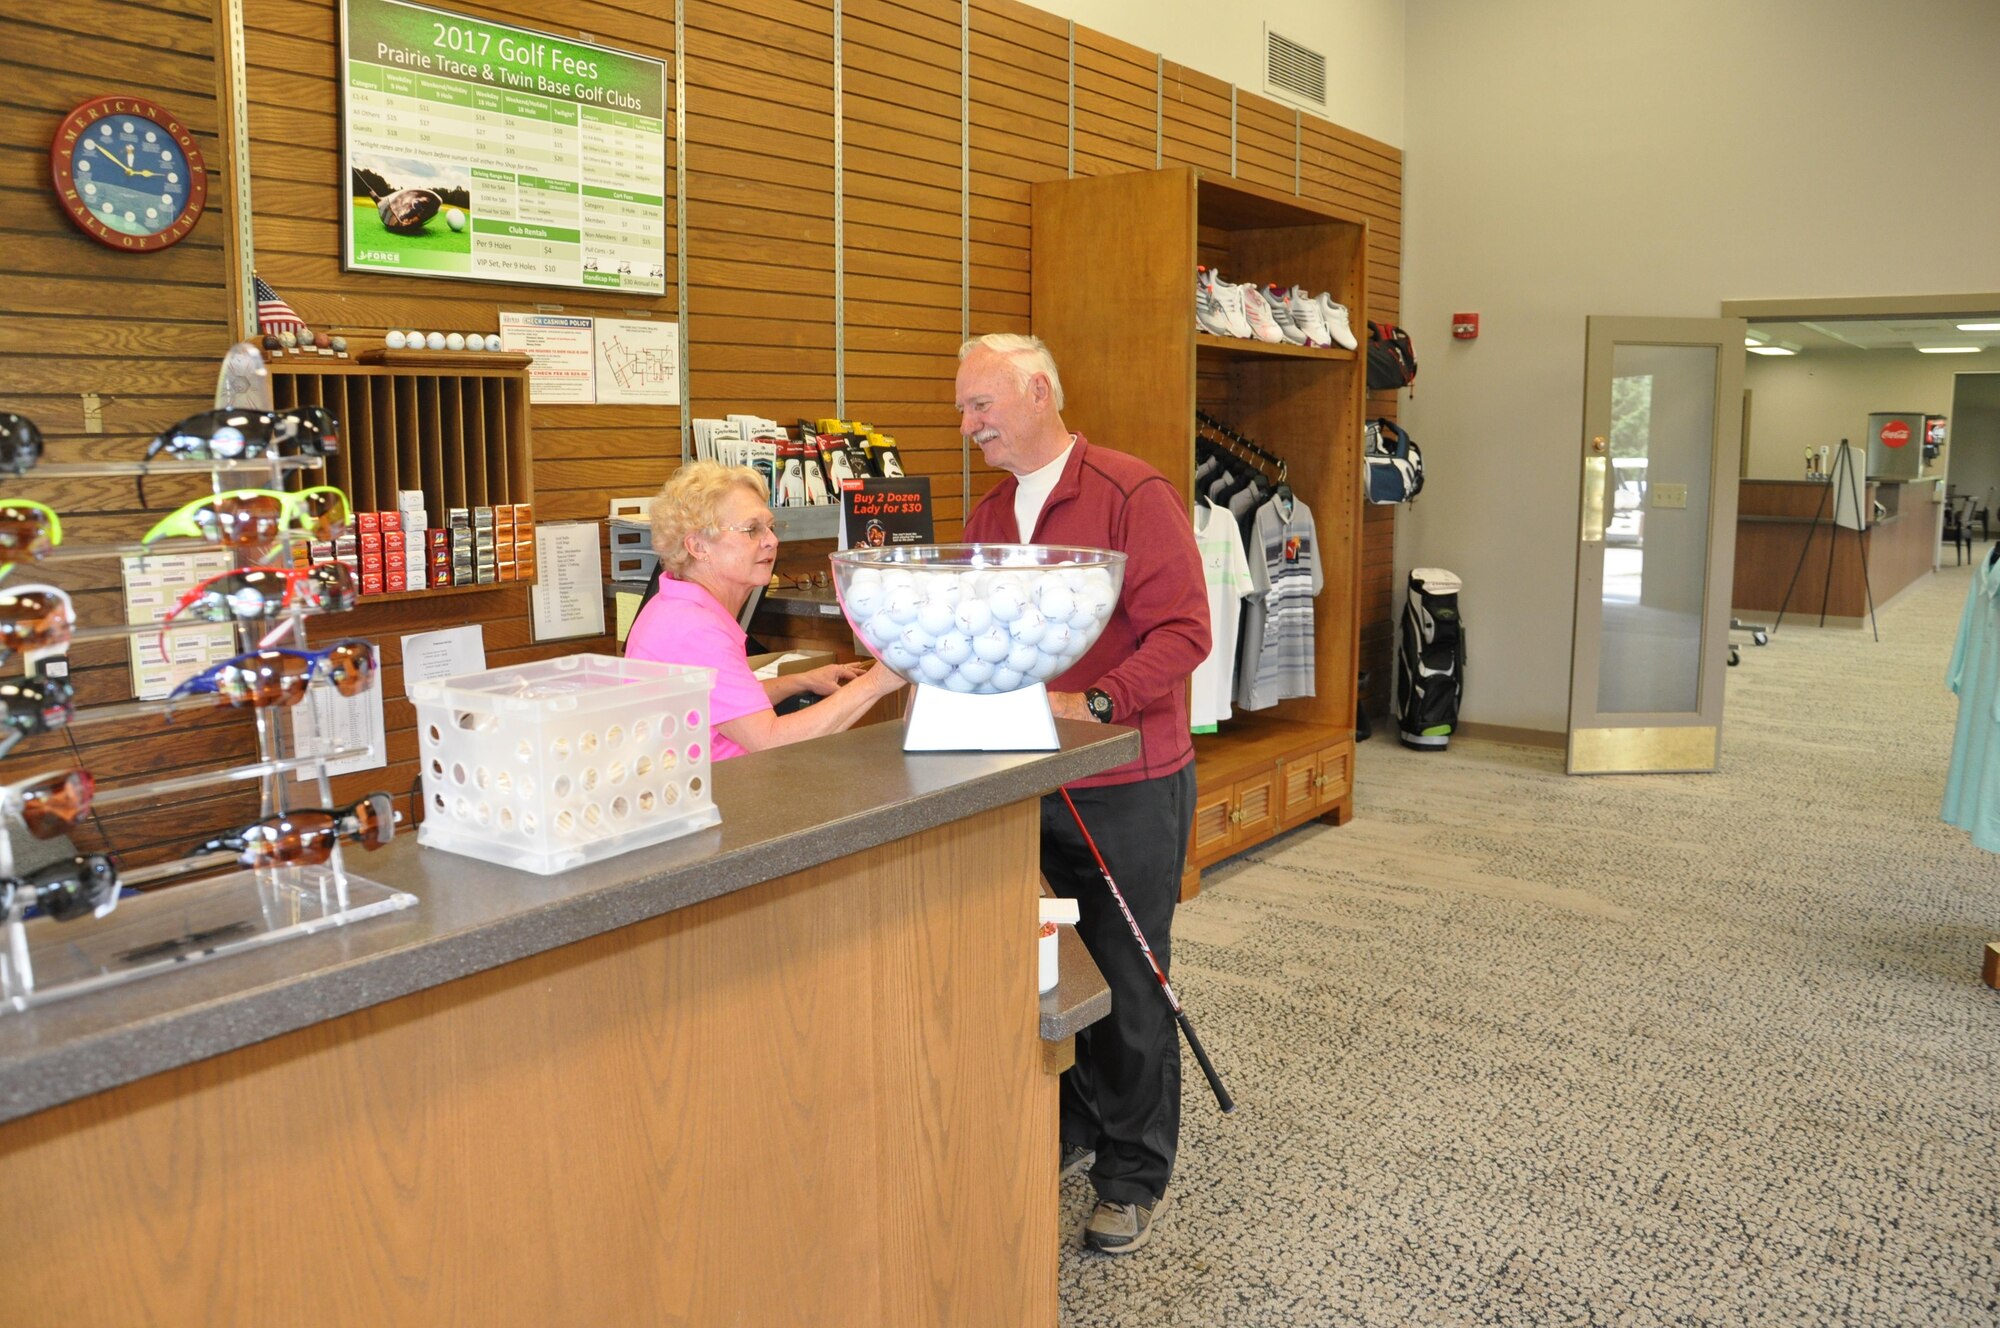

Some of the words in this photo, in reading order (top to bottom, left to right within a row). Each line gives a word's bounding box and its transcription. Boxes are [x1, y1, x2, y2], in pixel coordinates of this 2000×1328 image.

[432, 22, 491, 56] 2017
[498, 36, 545, 69] Golf
[552, 48, 597, 80] Fees
[377, 41, 431, 69] Prairie
[434, 54, 476, 78] Trace
[482, 63, 494, 80] &
[499, 67, 532, 88] Twin
[538, 76, 569, 96] Base
[574, 82, 604, 103] Golf
[606, 89, 641, 110] Clubs
[60, 102, 156, 158] AMERICAN
[169, 123, 202, 174] GOLF
[66, 190, 108, 238] HALL
[123, 238, 148, 248] OF
[160, 202, 200, 244] FAME
[509, 226, 523, 234] Club
[525, 228, 547, 237] Rentals
[489, 260, 500, 268] Set,
[854, 494, 875, 504] Buy
[877, 493, 884, 502] 2
[887, 493, 920, 502] Dozen
[854, 505, 880, 515] Lady
[883, 504, 899, 513] for
[902, 503, 922, 513] $30
